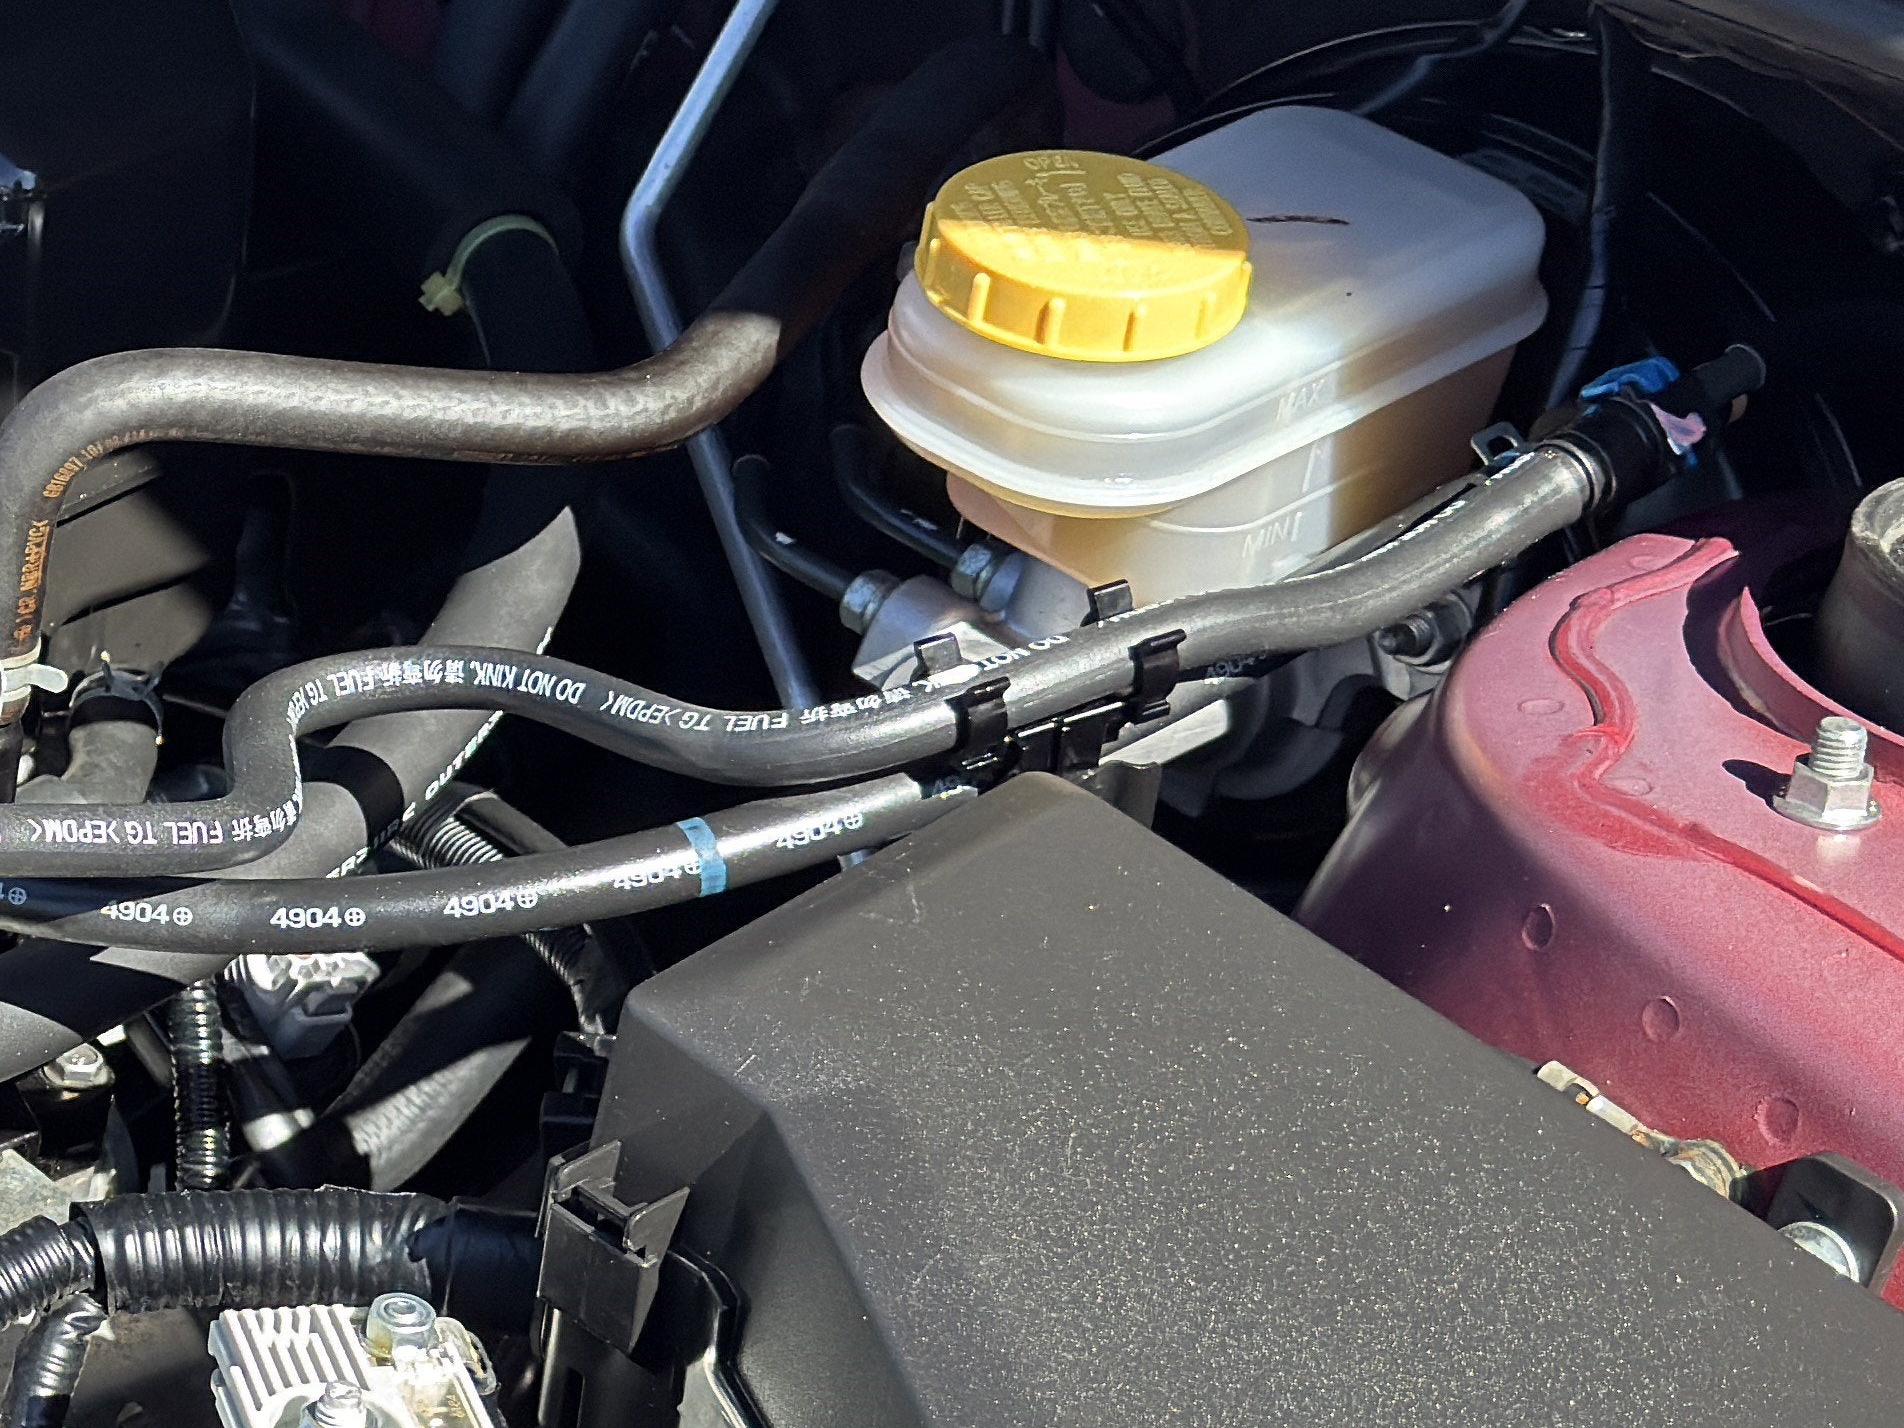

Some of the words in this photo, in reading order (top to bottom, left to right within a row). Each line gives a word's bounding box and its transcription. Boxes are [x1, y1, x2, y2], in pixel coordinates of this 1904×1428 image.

[304, 677, 328, 708] TG
[326, 664, 376, 697] FUEL
[517, 669, 554, 697] NOT
[555, 676, 587, 704] DO
[679, 713, 712, 732] TG
[724, 711, 788, 732] FUEL
[26, 814, 118, 849] >EPDM<
[124, 818, 156, 845] TG
[163, 817, 223, 844] FUEL
